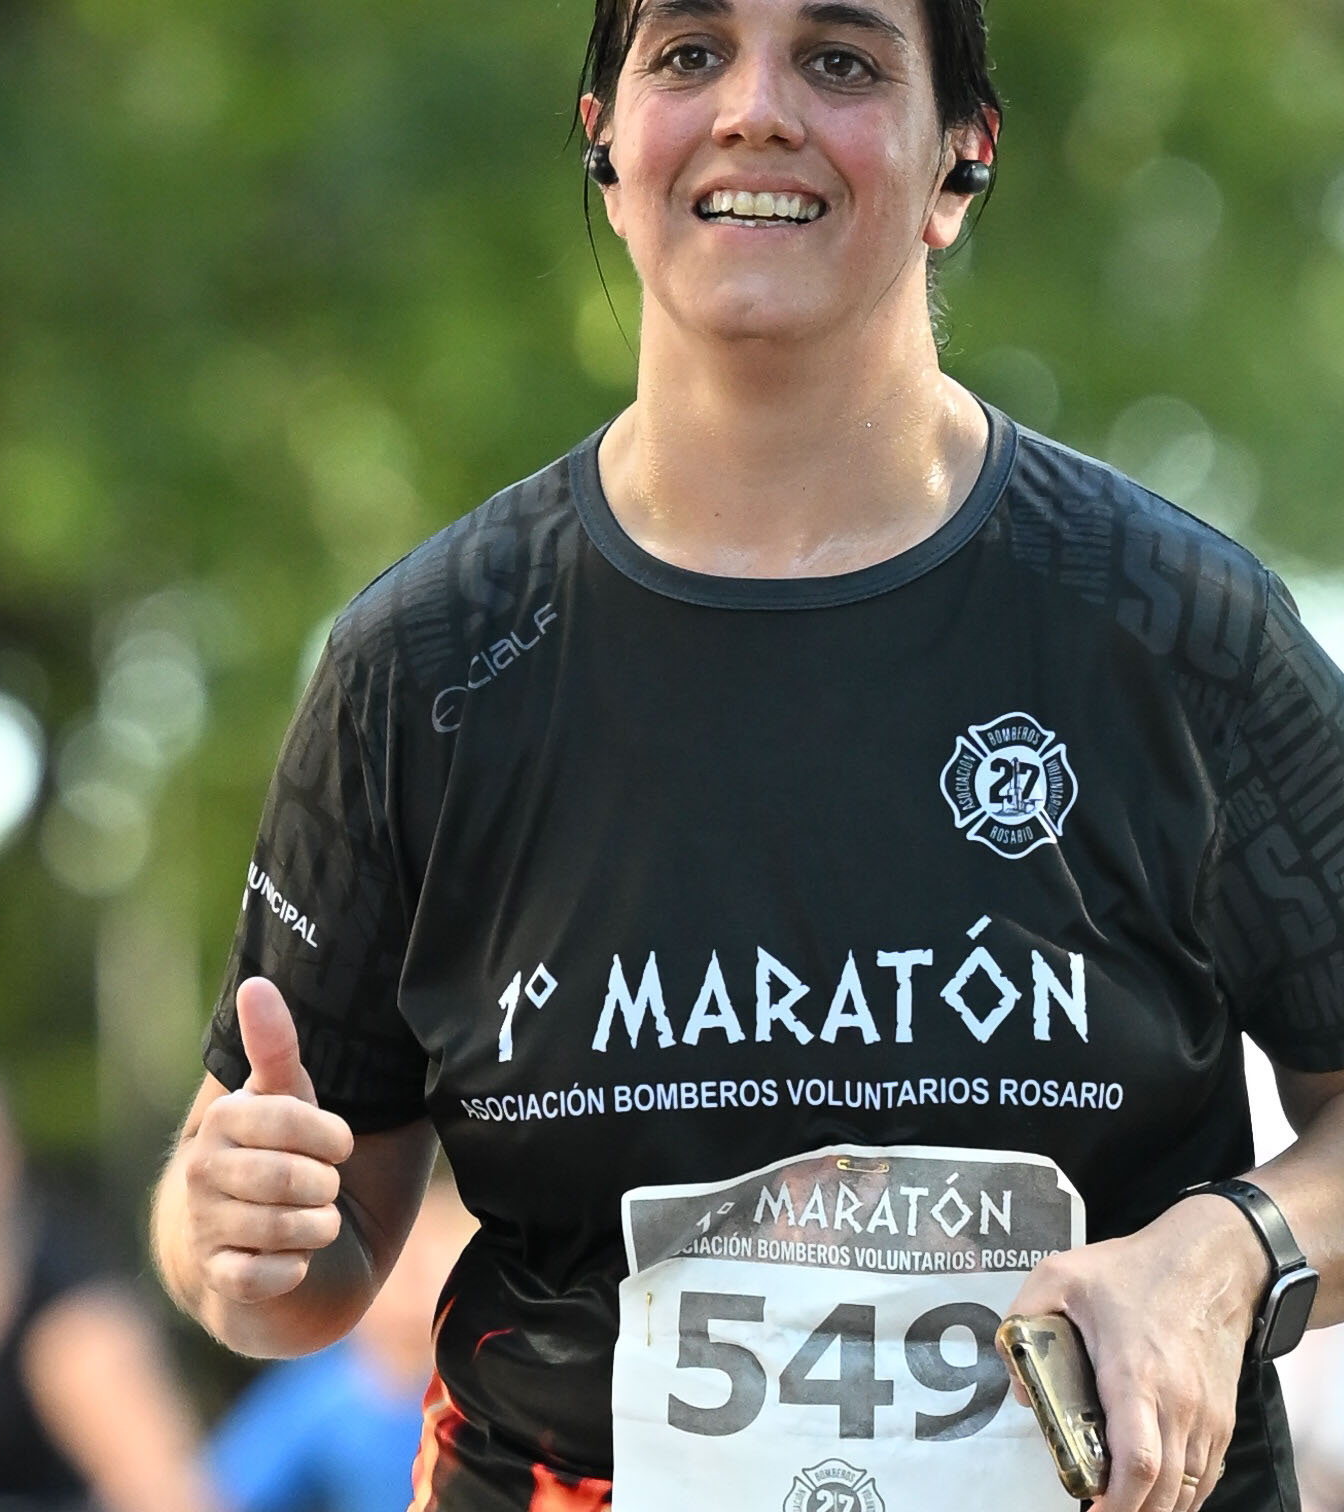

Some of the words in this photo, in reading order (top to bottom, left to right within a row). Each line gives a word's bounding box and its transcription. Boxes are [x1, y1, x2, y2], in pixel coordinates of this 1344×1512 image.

[987, 726, 1040, 746] BOMBEROS
[989, 757, 1041, 804] 27
[989, 825, 1034, 845] ROSARIO
[592, 915, 1089, 1051] MARATÓN
[460, 1082, 605, 1122] ASOCIACIÓN
[614, 1080, 778, 1114] BOMBEROS
[786, 1077, 989, 1110] VOLUNTARIOS
[1000, 1079, 1124, 1110] ROSARIO
[753, 1172, 1012, 1238] MARATÓN
[757, 1239, 851, 1266] BOMBEROS
[855, 1245, 976, 1271] VOLUNTARIOS
[981, 1248, 1061, 1269] ROSAR
[667, 1291, 1013, 1442] 549
